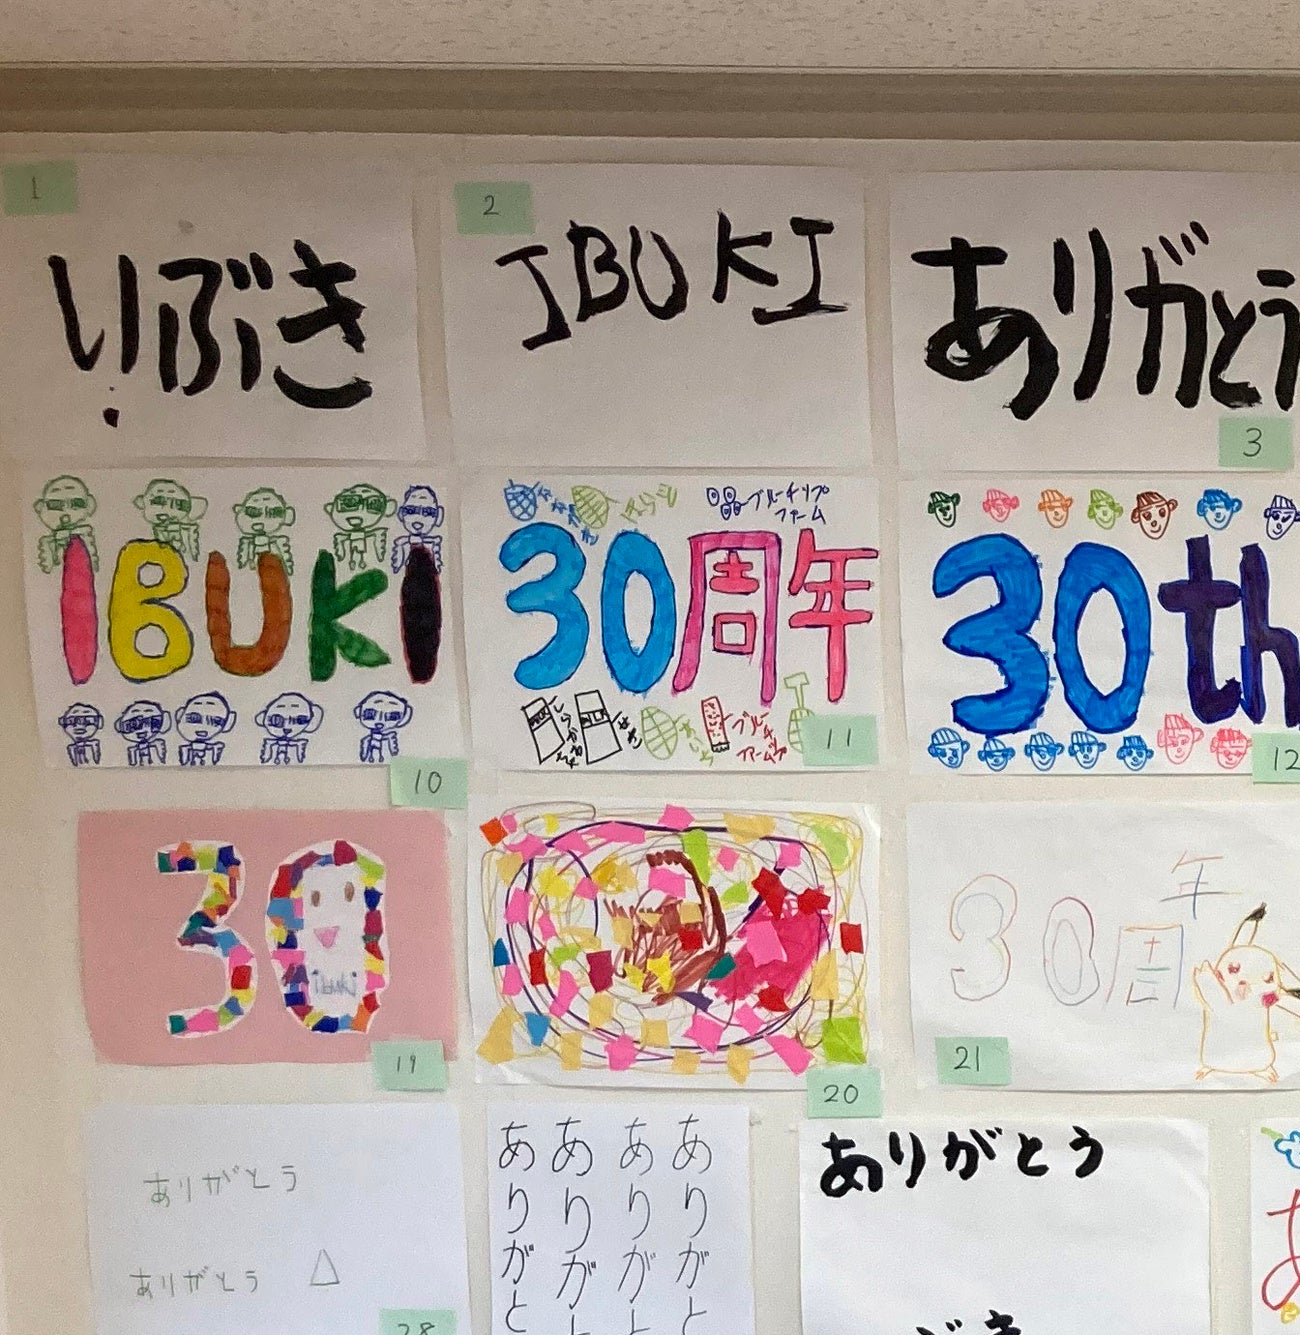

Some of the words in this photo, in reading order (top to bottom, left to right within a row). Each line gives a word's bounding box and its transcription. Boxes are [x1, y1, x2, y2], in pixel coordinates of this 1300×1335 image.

[483, 195, 500, 217] 2
[495, 211, 853, 349] IBUKI
[48, 240, 372, 409] いぶき
[1242, 429, 1262, 457] 3
[59, 534, 443, 686] IBUKI
[499, 521, 879, 706] 30周年
[827, 729, 852, 749] 11
[413, 770, 443, 795] 10
[155, 840, 389, 1034] 30
[395, 1053, 420, 1074] 19
[953, 1046, 983, 1073] 21
[822, 1083, 860, 1106] 20
[818, 1124, 1106, 1199] ありがとう
[142, 1164, 299, 1207] ありがとう
[130, 1265, 261, 1301] ありがとう
